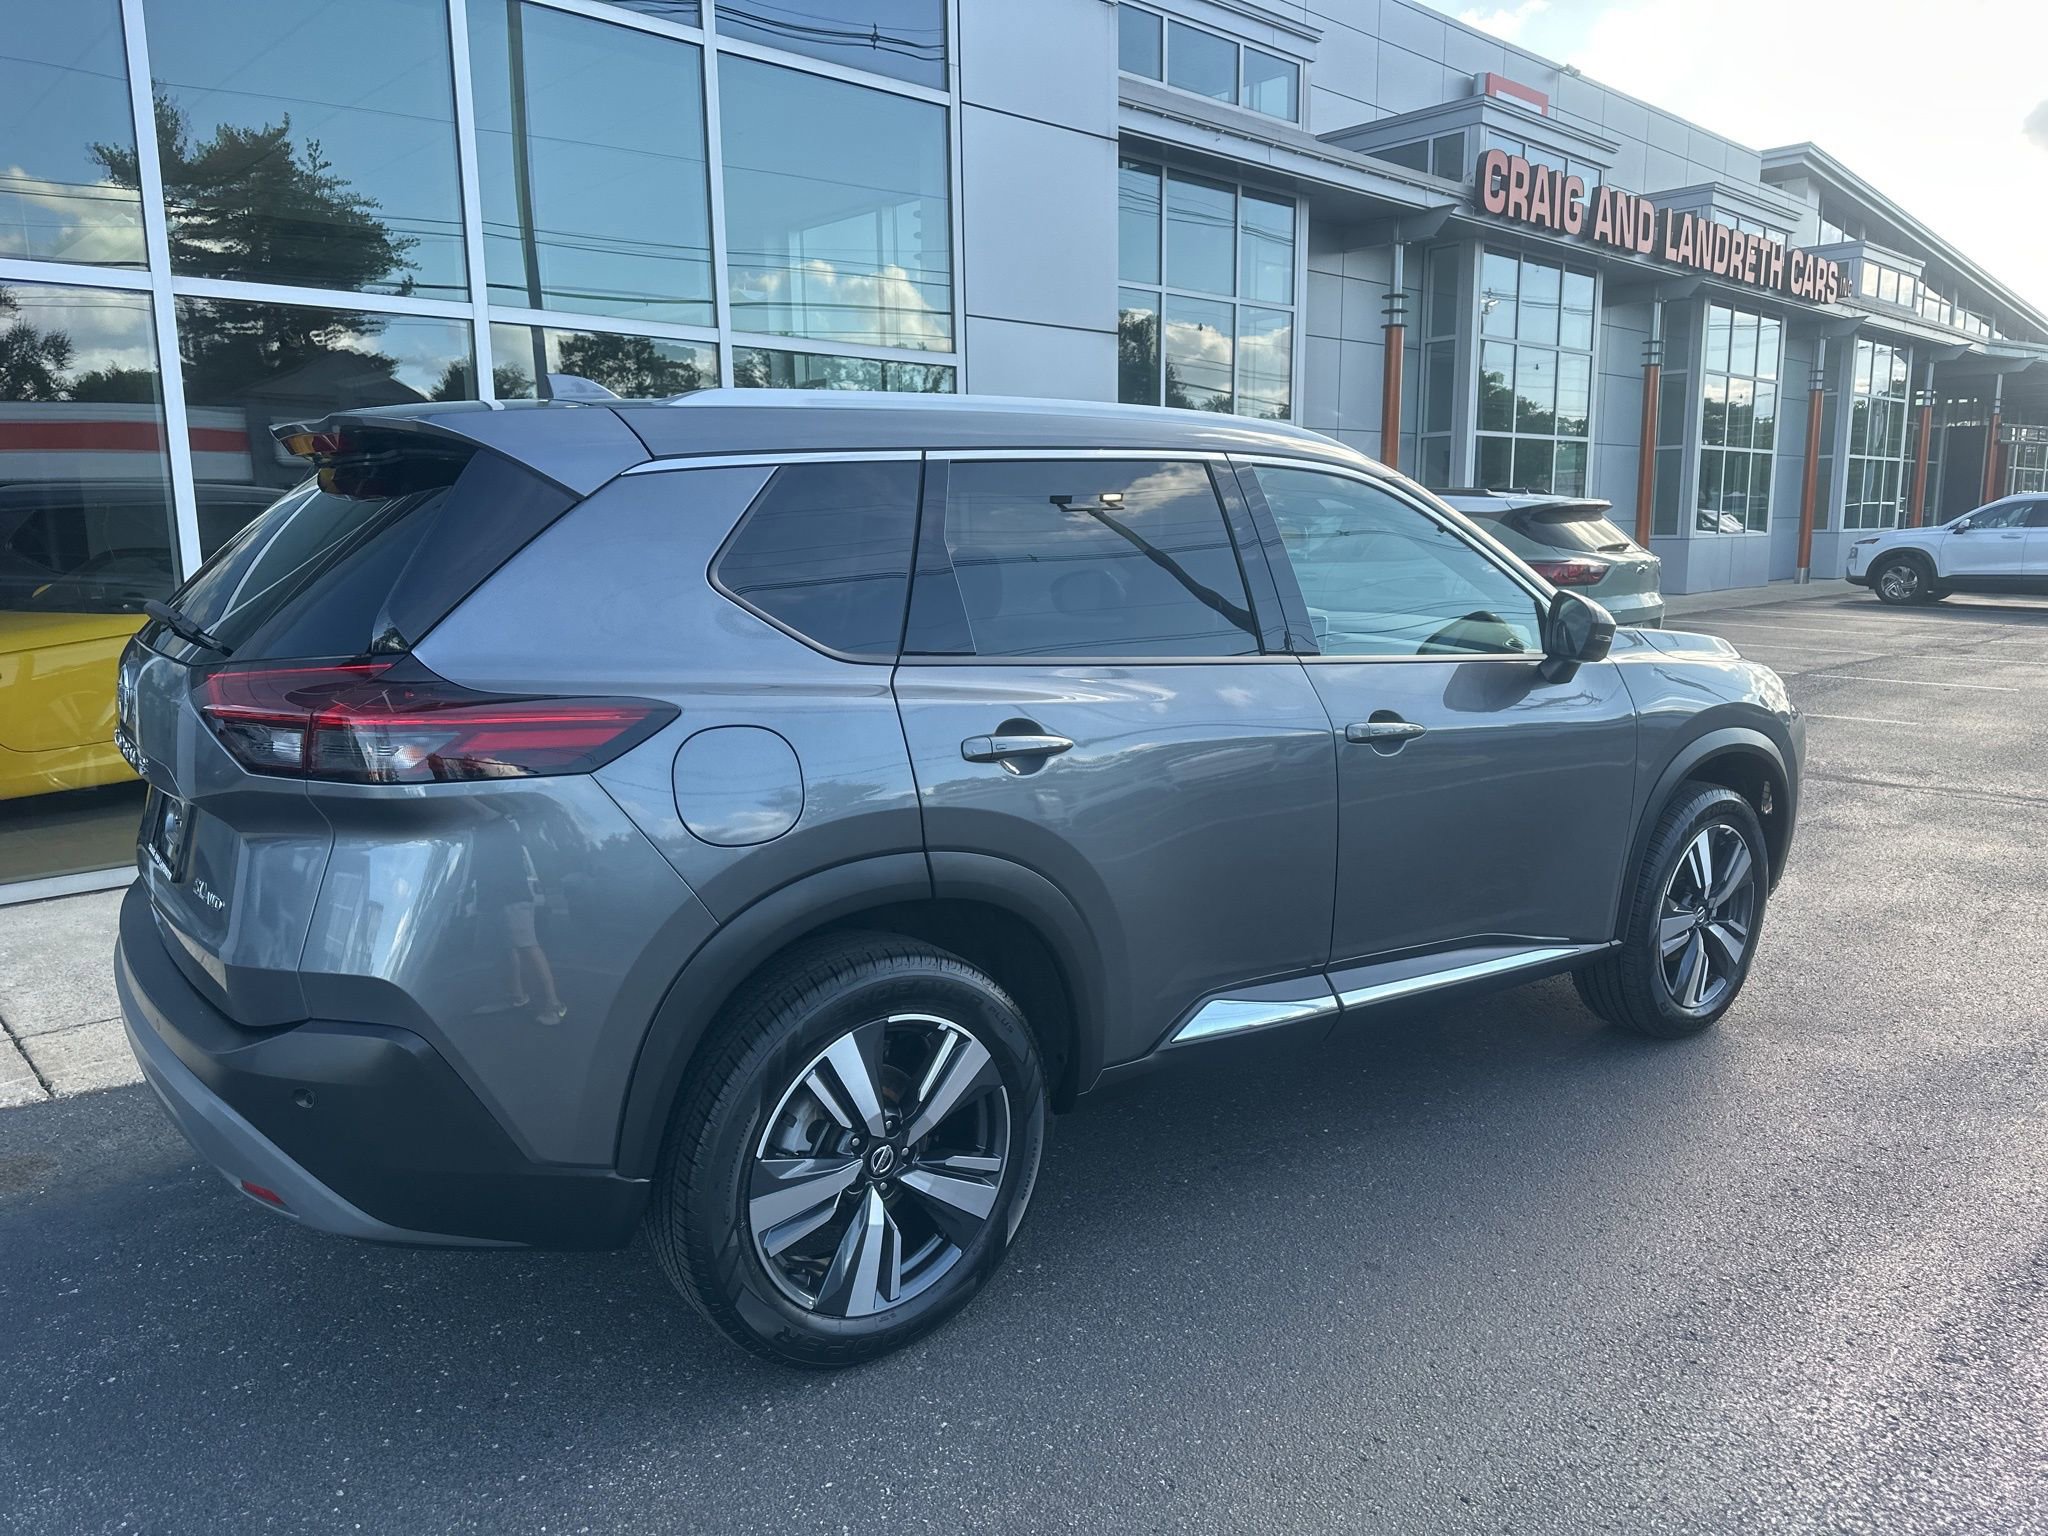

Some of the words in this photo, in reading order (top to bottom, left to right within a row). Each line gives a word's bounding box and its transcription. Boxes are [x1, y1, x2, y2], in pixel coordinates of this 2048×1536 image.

[1480, 148, 1585, 235] CRAIG
[1593, 185, 1656, 254] AND
[1664, 207, 1785, 290] LANDRETH
[1789, 249, 1839, 304] CARS
